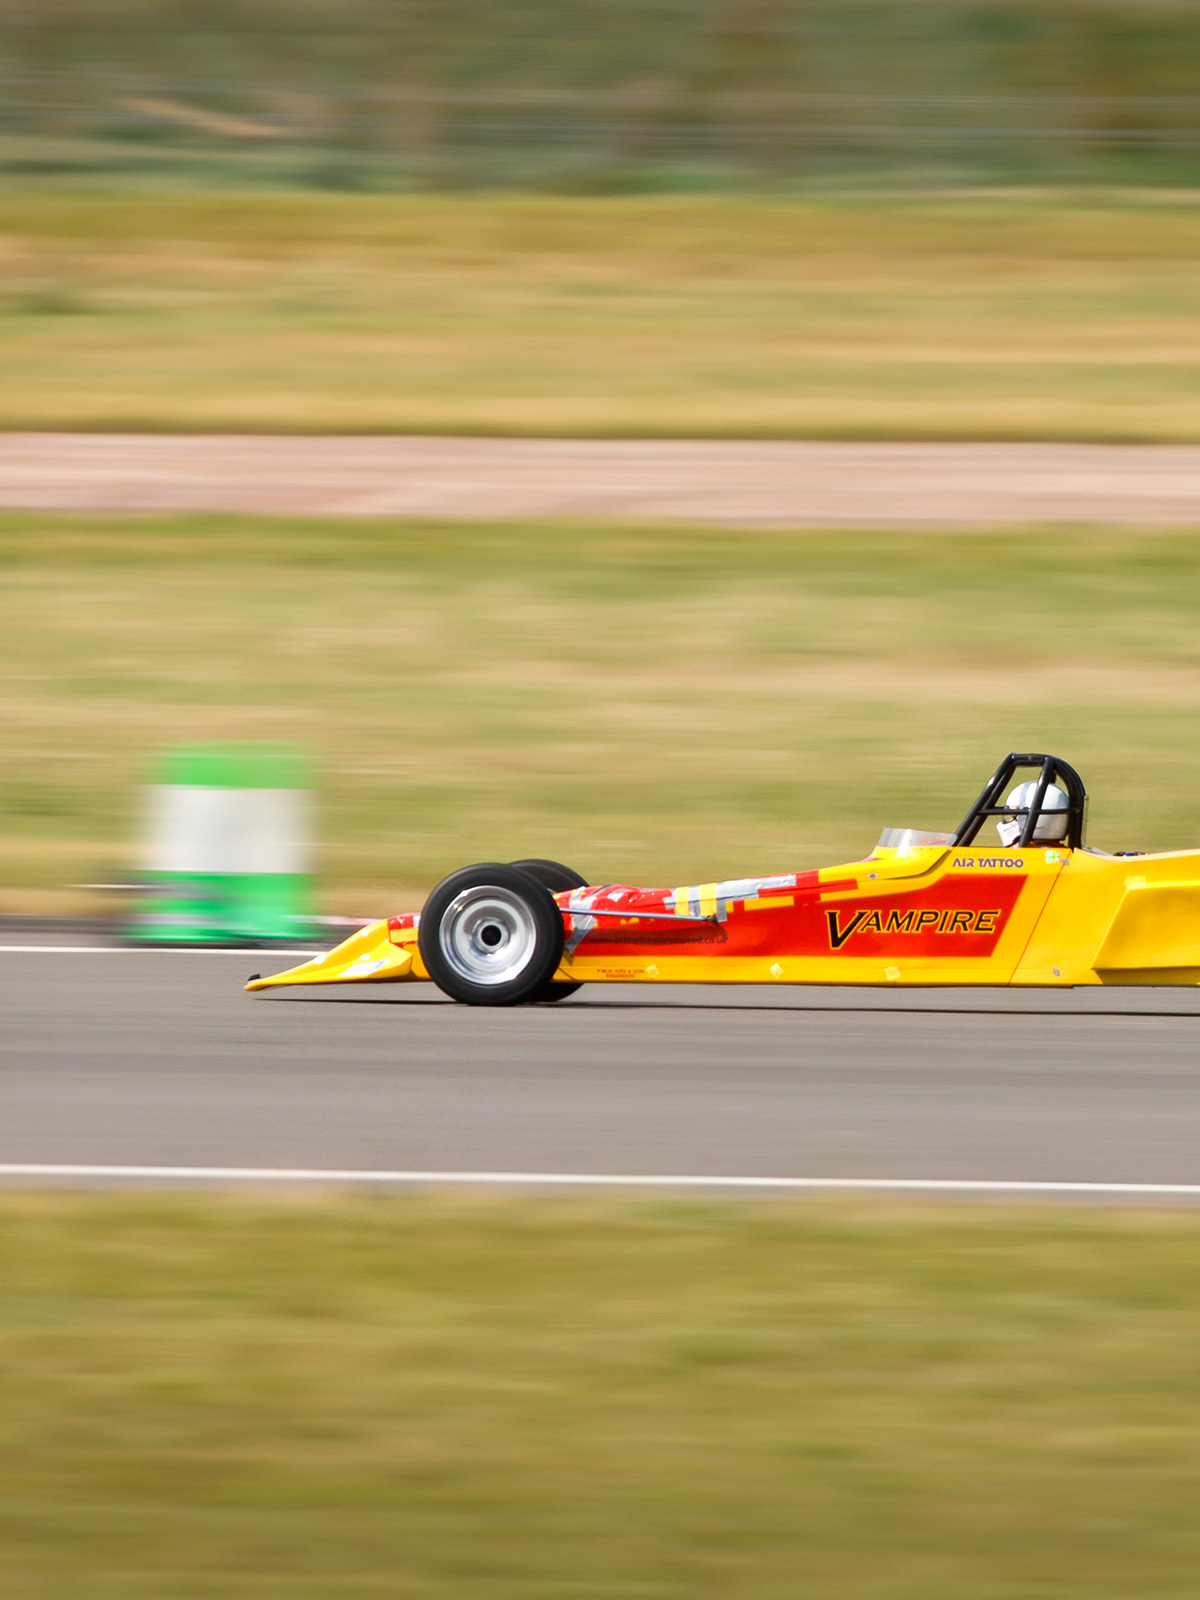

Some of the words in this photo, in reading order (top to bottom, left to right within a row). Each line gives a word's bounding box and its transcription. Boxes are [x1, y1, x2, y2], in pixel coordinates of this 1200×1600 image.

[952, 857, 975, 868] AIR
[978, 858, 1024, 868] TATTOO
[824, 909, 1001, 950] VAMPIRE
